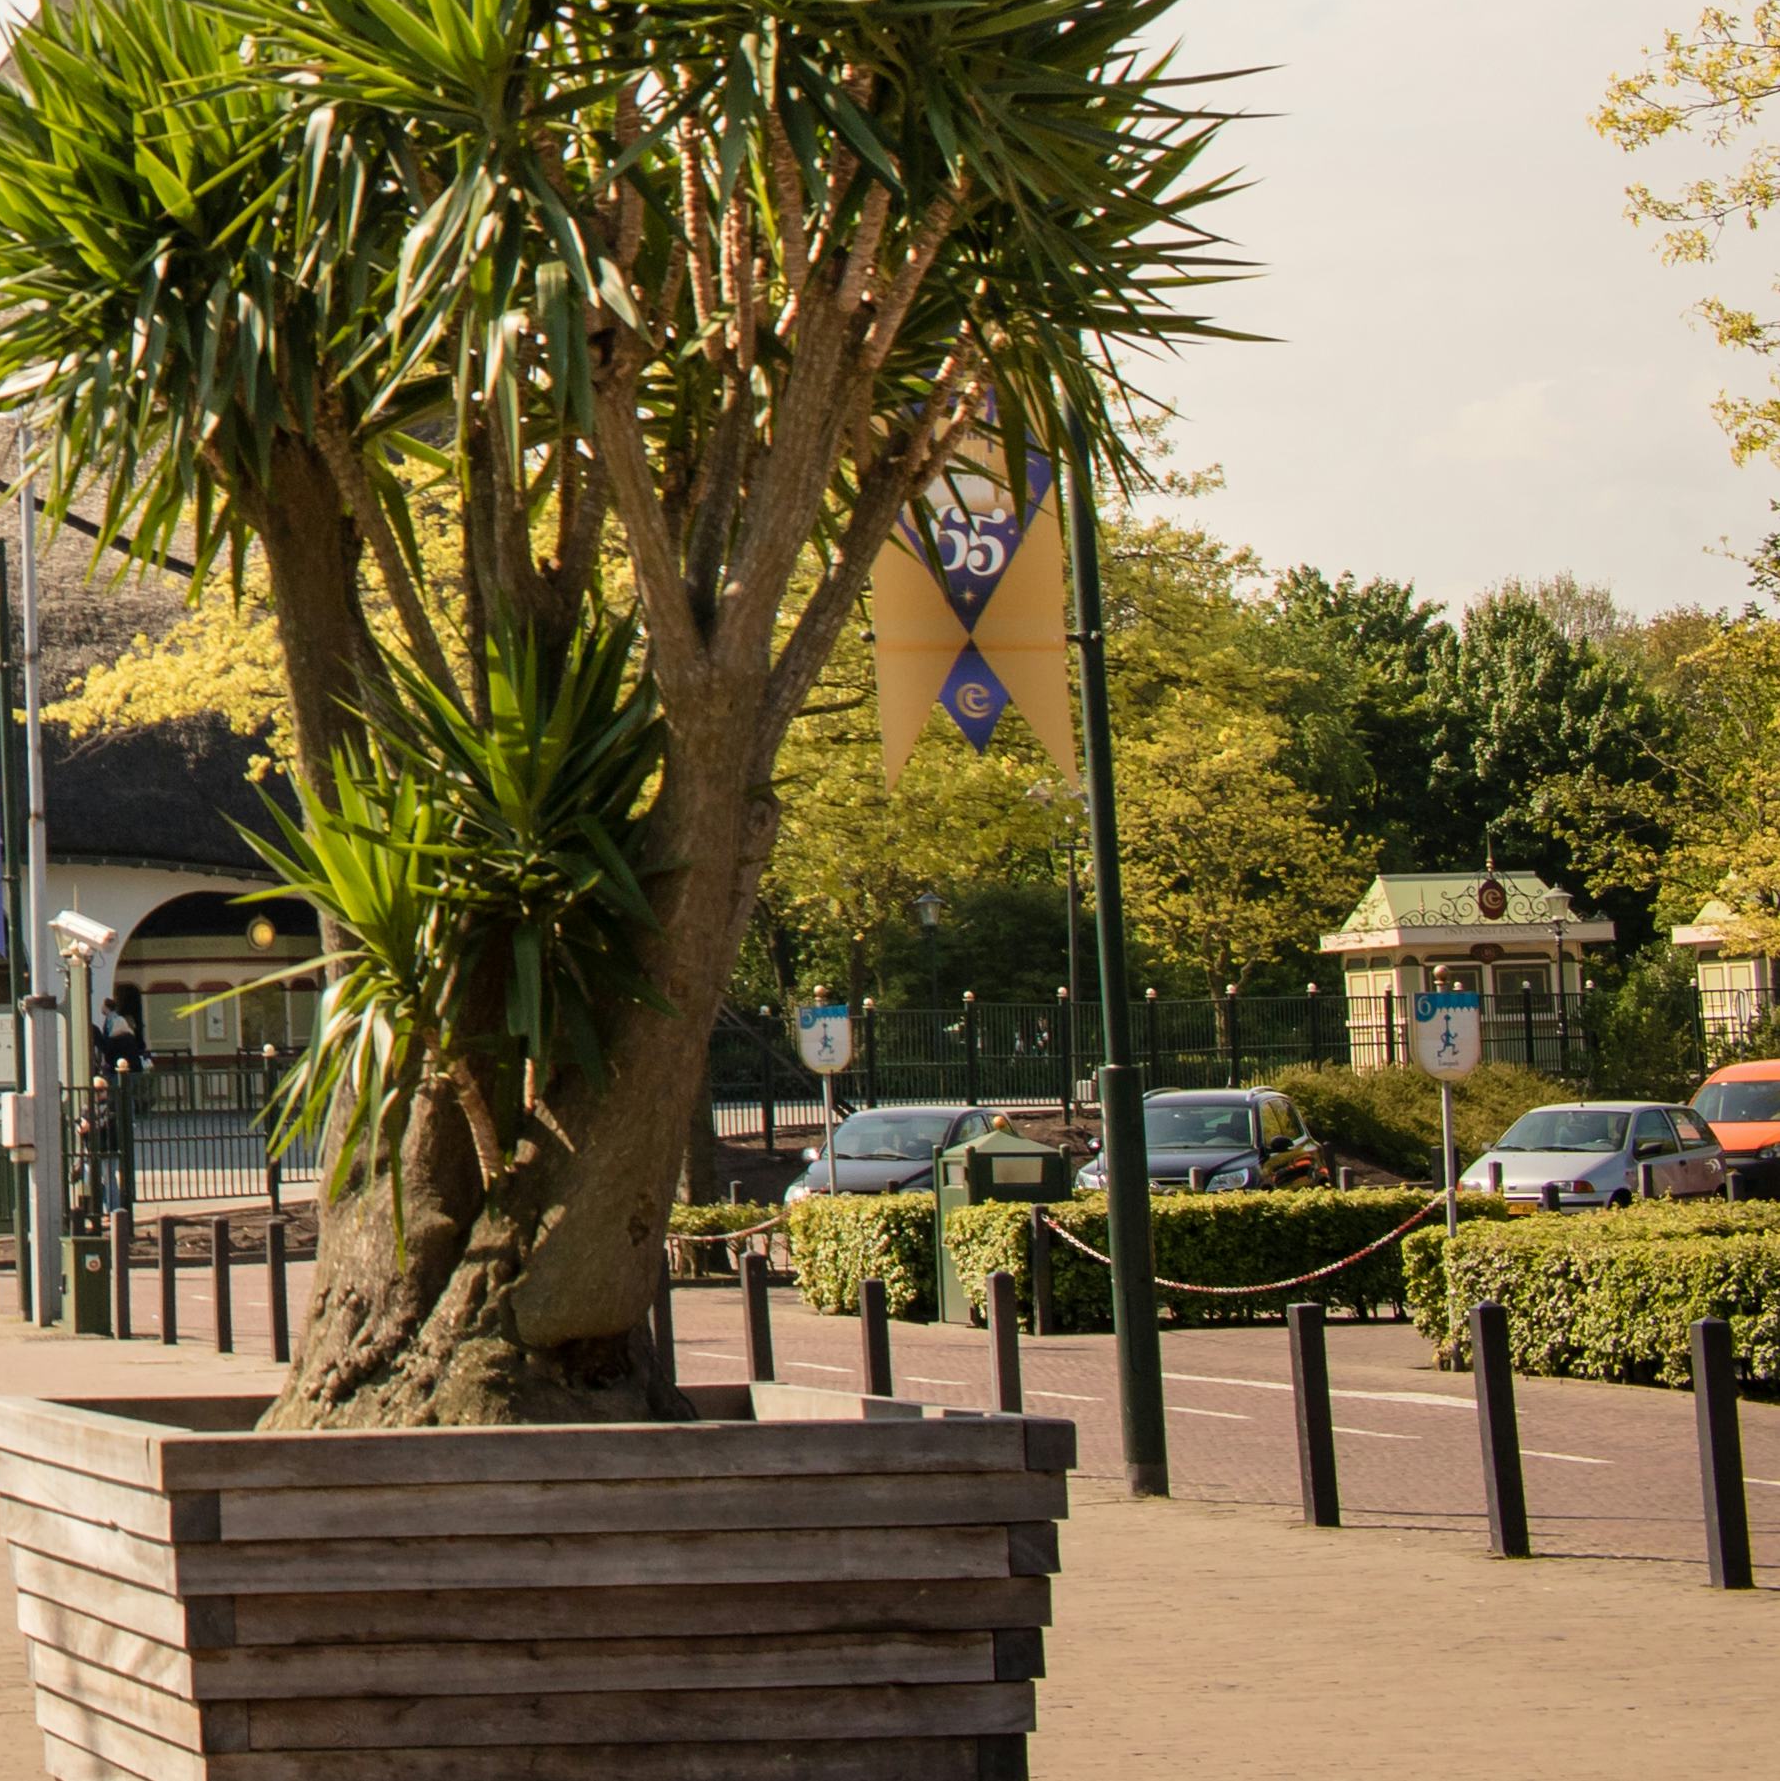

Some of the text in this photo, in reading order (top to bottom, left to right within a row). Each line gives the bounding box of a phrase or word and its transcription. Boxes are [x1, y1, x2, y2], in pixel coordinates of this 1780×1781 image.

[928, 504, 1007, 576] 65
[1418, 995, 1432, 1016] 6
[801, 1009, 813, 1025] 5
